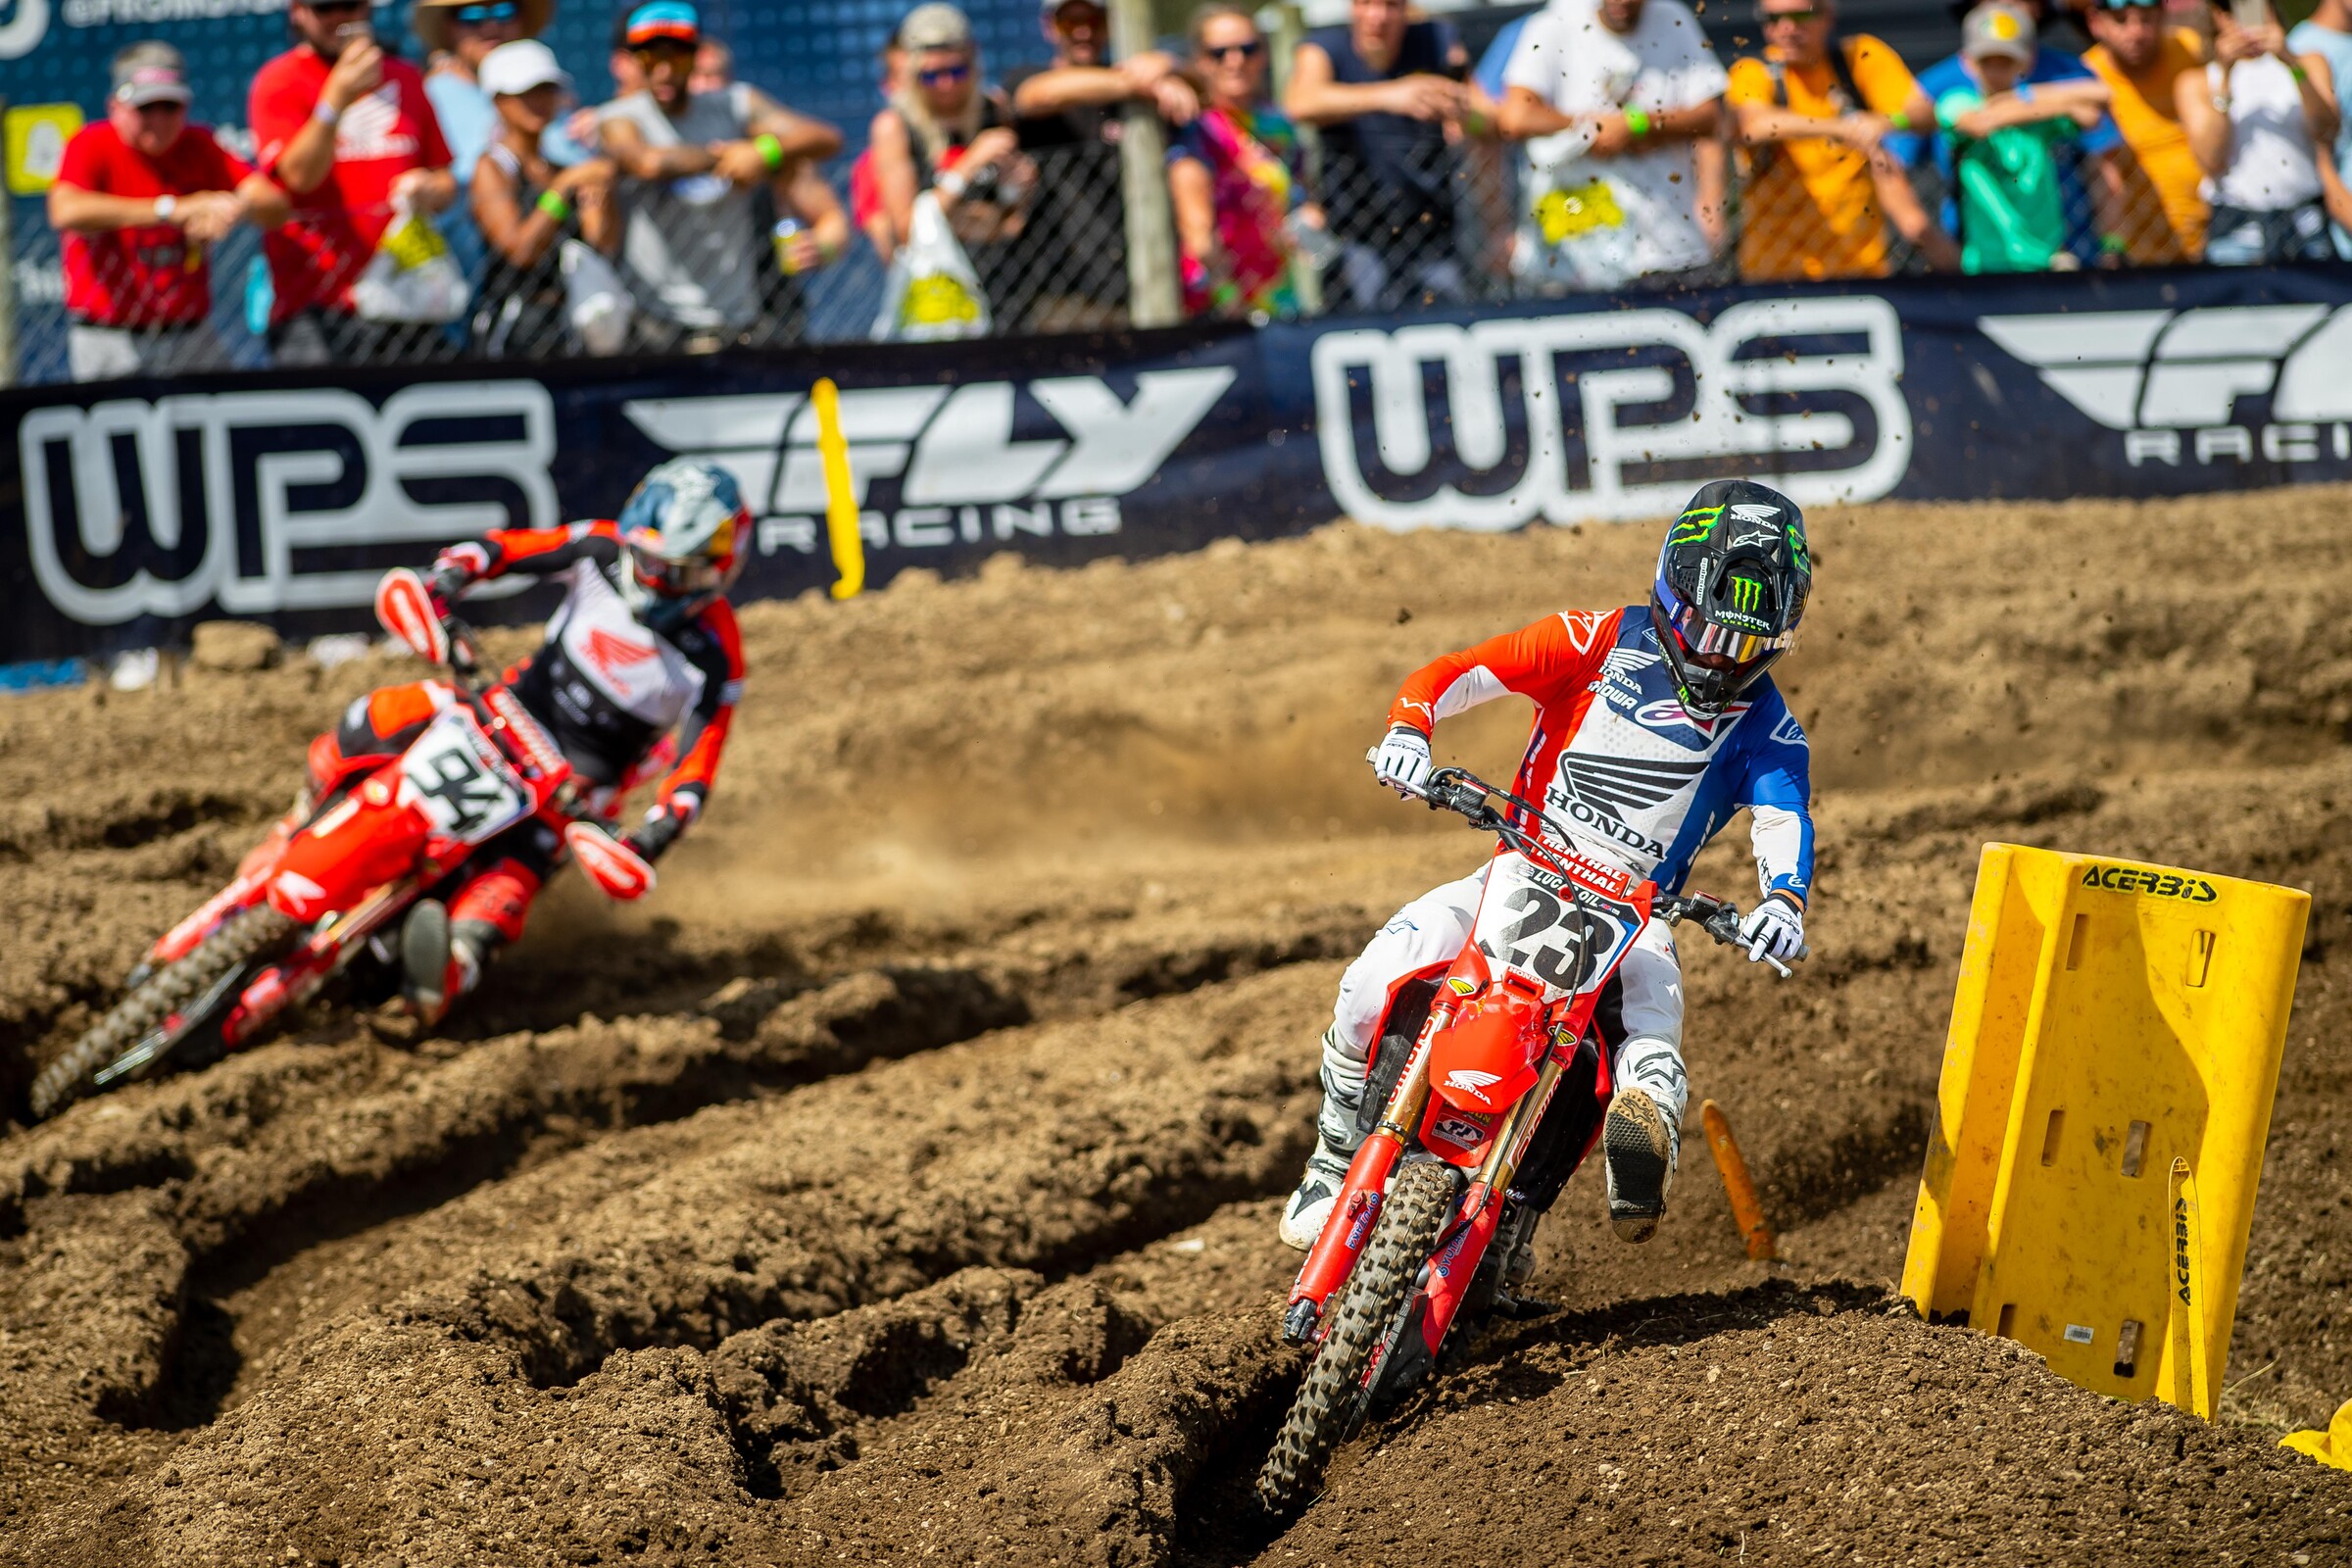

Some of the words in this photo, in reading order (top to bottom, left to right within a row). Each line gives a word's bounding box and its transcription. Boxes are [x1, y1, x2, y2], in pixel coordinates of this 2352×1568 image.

[1311, 296, 1913, 531] WPS
[623, 366, 1237, 514] FLY
[20, 378, 561, 625] WPS
[1730, 514, 1781, 533] HONDA
[1715, 610, 1771, 631] MONSTER
[1722, 618, 1762, 632] ENERGY
[405, 747, 505, 832] 94
[1544, 785, 1664, 860] HONDA
[1542, 837, 1626, 881] RENTHAL
[1533, 870, 1579, 891] LUC
[1578, 891, 1598, 908] OIL
[2082, 865, 2218, 903] ACERBIS
[1478, 887, 1616, 991] 23
[1508, 966, 1544, 987] HONDA
[1443, 1080, 1493, 1105] HONDA
[2175, 1197, 2191, 1307] ACERBIS
